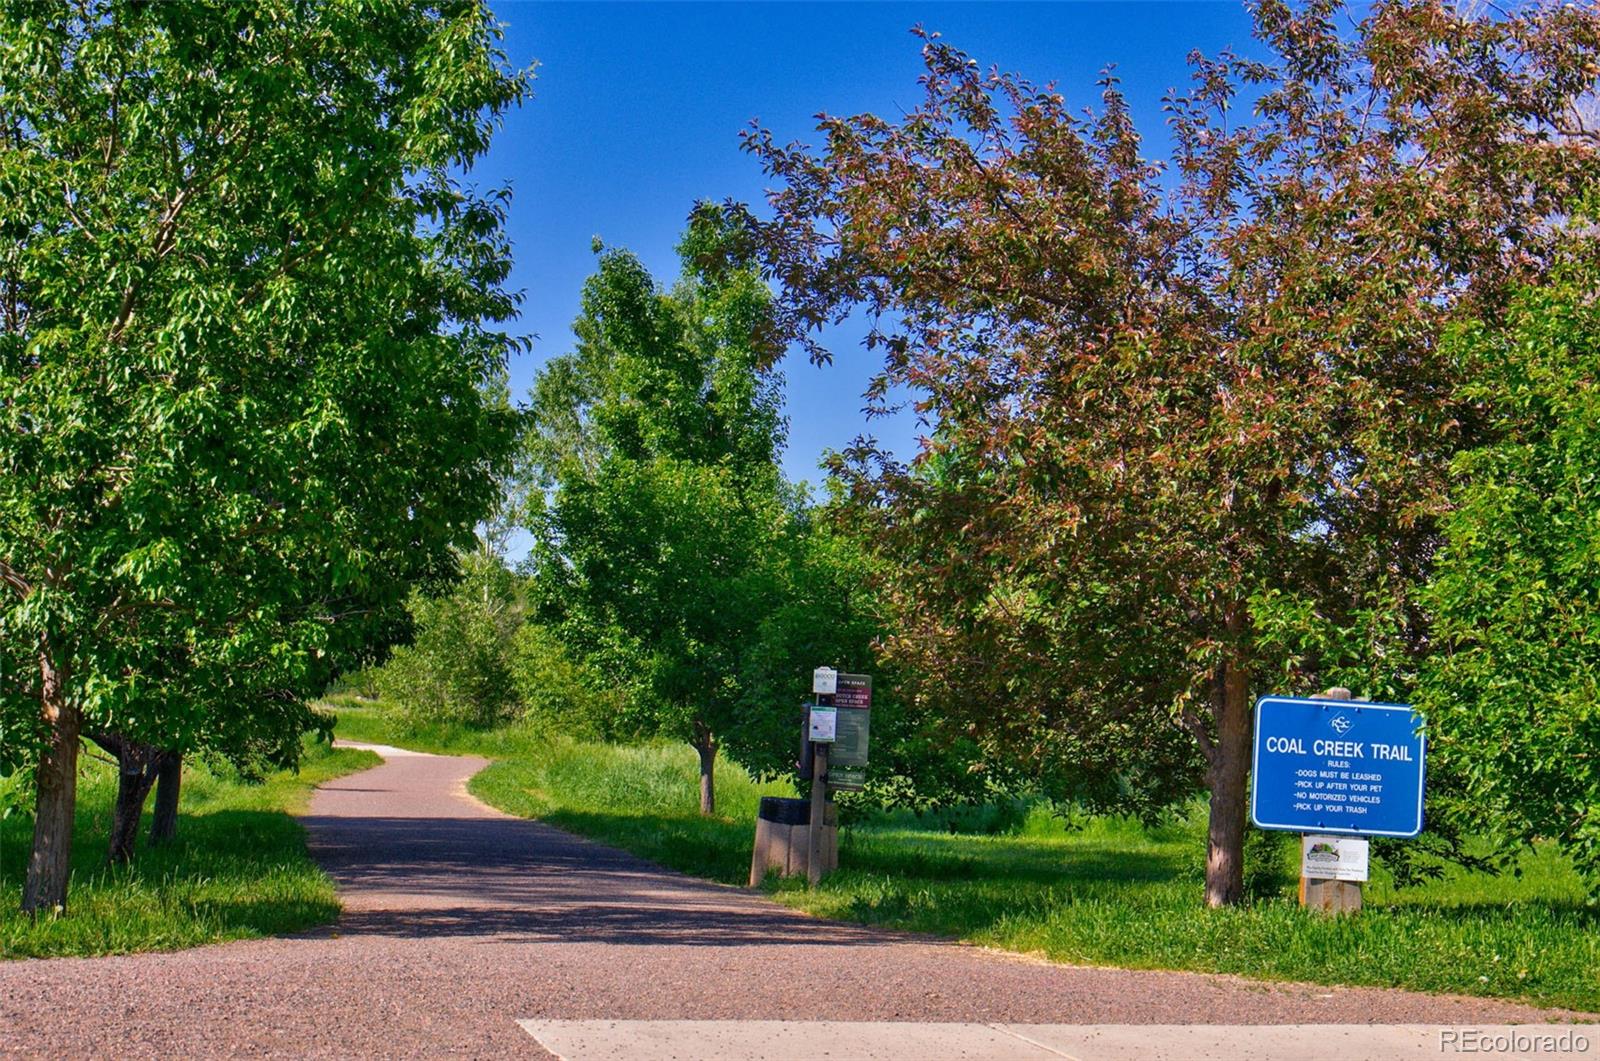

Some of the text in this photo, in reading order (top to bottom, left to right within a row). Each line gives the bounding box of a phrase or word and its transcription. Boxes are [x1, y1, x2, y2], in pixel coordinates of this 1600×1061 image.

[1266, 736, 1413, 761] COAL CREEK TRAIL
[1327, 760, 1351, 768] RULES:
[1295, 769, 1382, 781] -DOGS MUST BE LEASHED
[1315, 781, 1324, 789] UP
[1326, 782, 1347, 790] AFTER
[1350, 783, 1368, 792] YOUR
[1309, 792, 1347, 802] MOTORIZED
[1349, 795, 1381, 804] VEHICLES
[1313, 803, 1323, 811] UP
[1325, 804, 1343, 813] YOUR
[1345, 805, 1368, 814] TRASH
